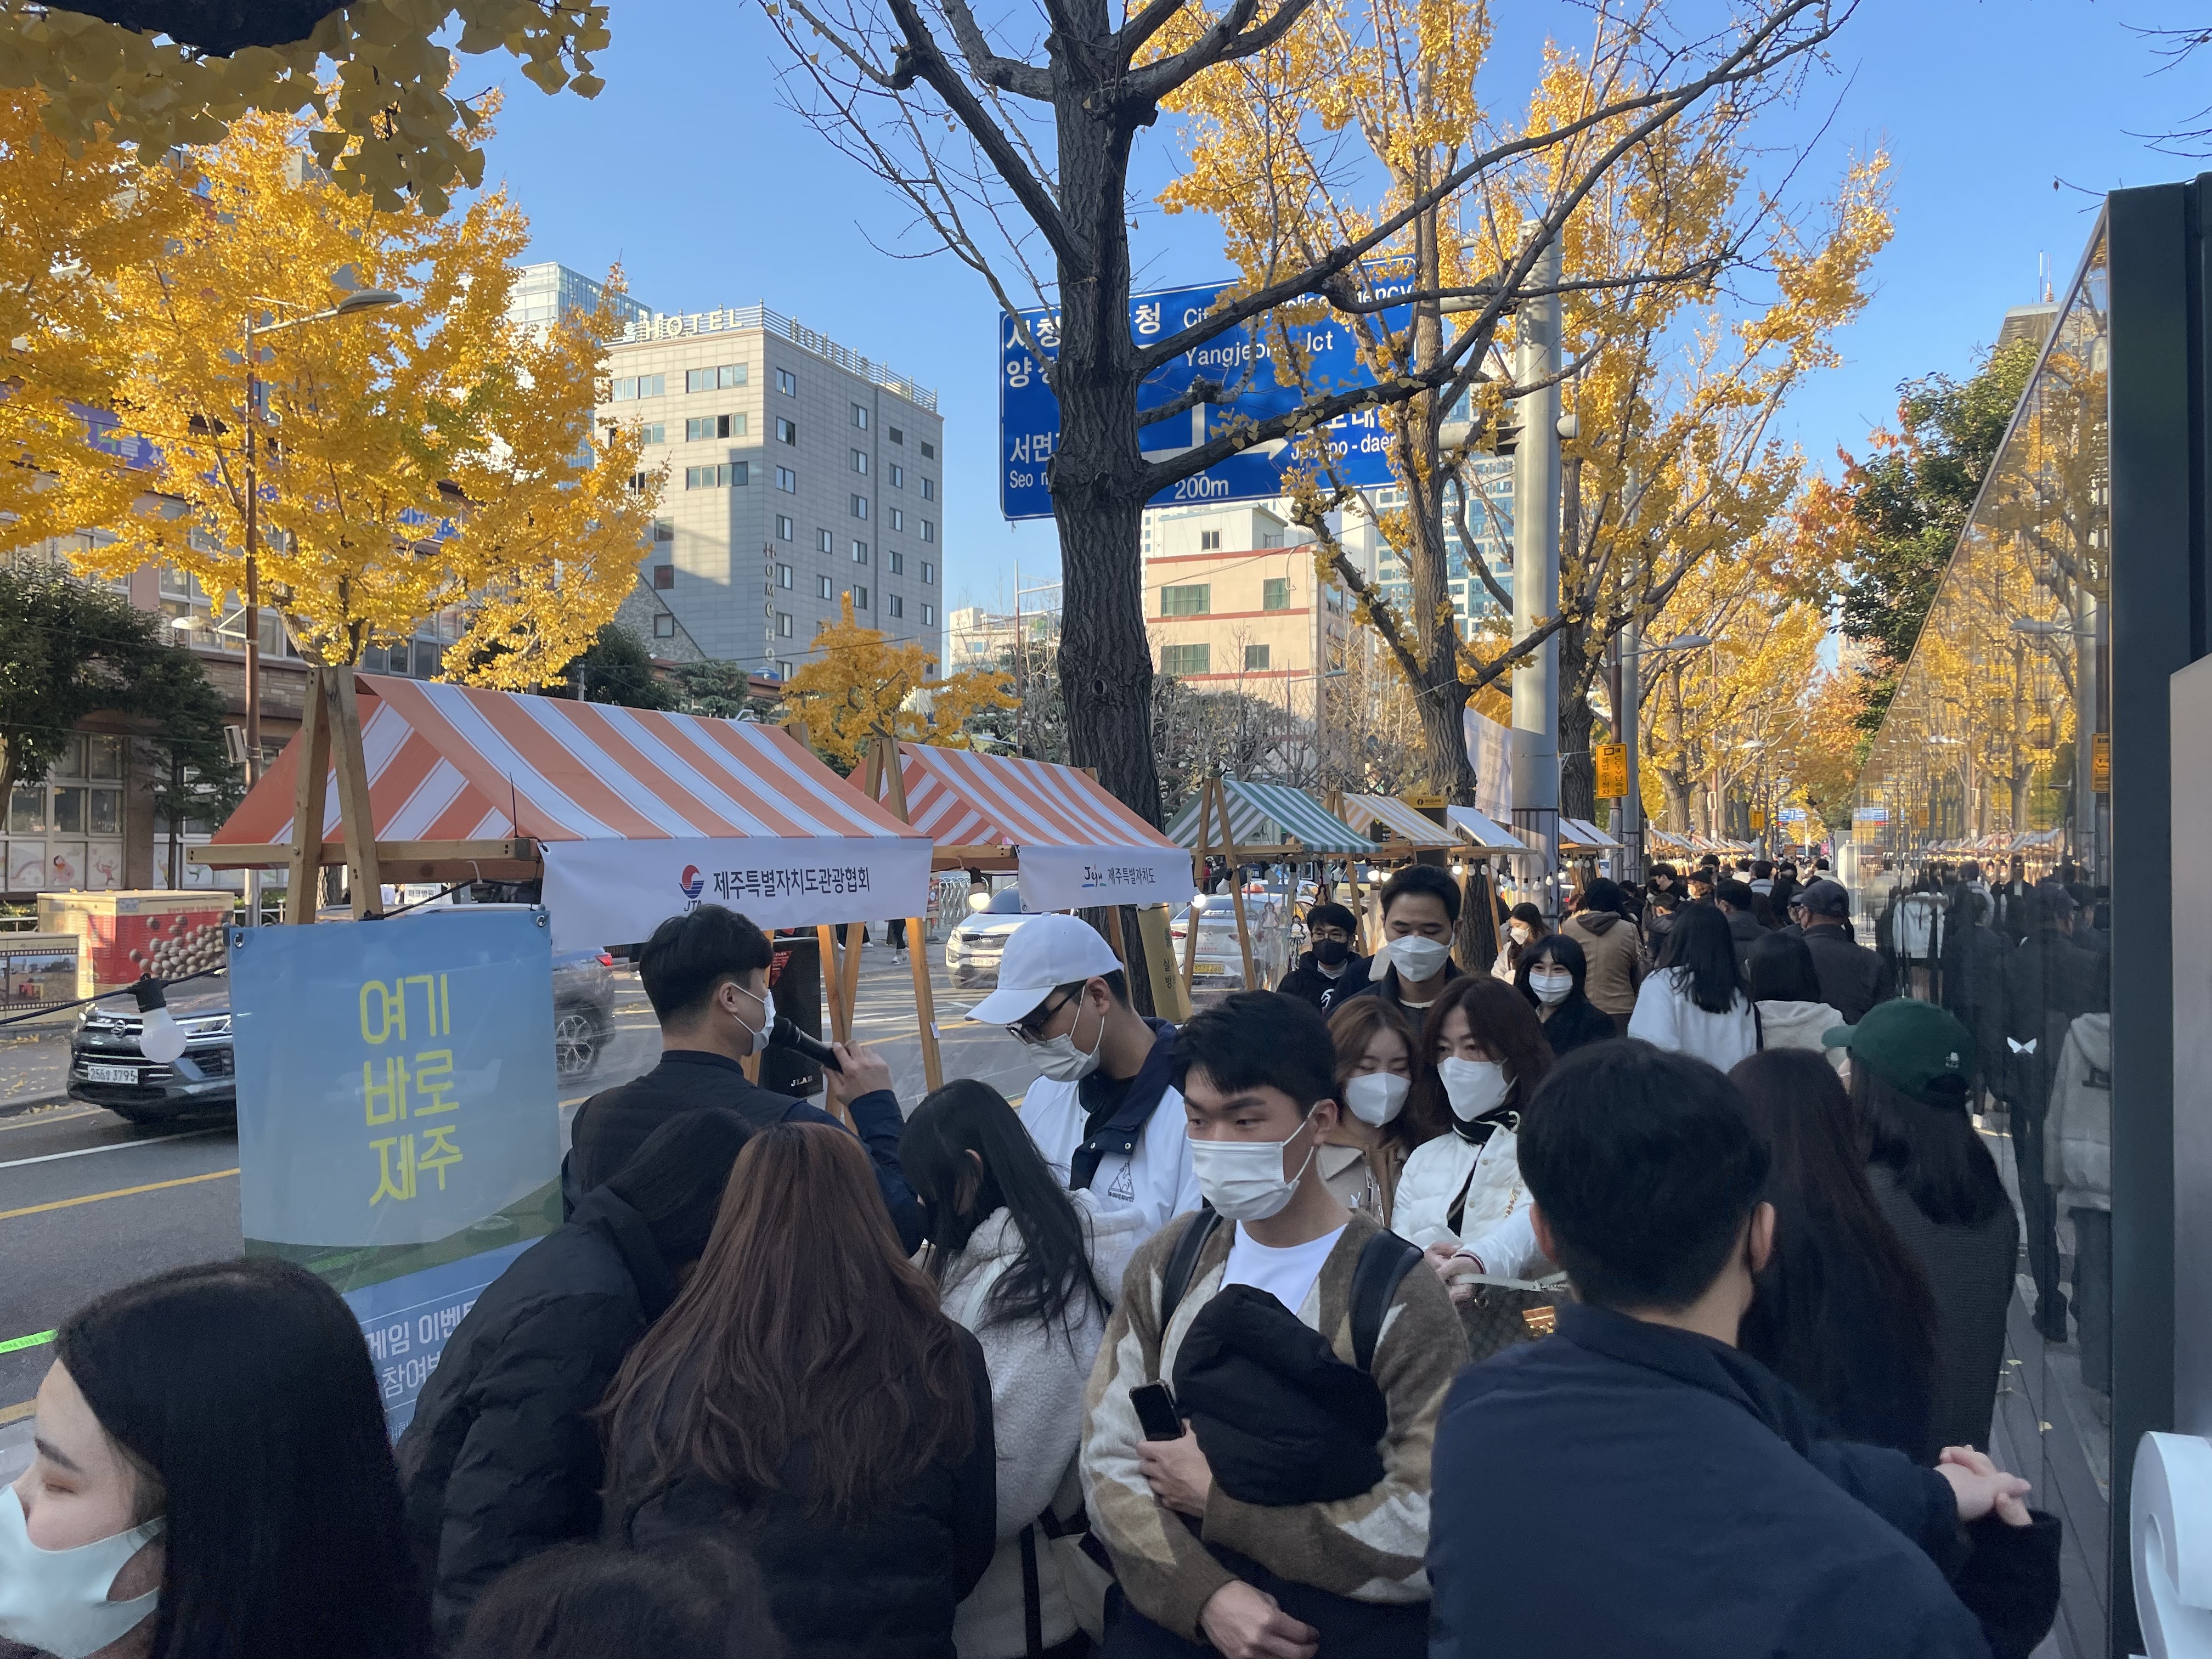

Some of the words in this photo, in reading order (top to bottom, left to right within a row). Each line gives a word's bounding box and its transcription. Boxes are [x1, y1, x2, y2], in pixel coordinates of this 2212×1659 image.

[645, 309, 743, 340] HOTEL
[790, 320, 849, 367] HOTEL
[1305, 331, 1334, 353] Jct
[1009, 470, 1034, 489] Seo
[1175, 476, 1229, 500] 200m
[713, 866, 870, 900] 제주특별자치도관광협회
[1084, 864, 1103, 888] Jeju
[1107, 867, 1156, 885] 제주특별자치도
[360, 973, 450, 1045] 여기
[363, 1048, 460, 1126] 바로
[791, 1075, 813, 1087] JLAB
[369, 1124, 464, 1207] 제주
